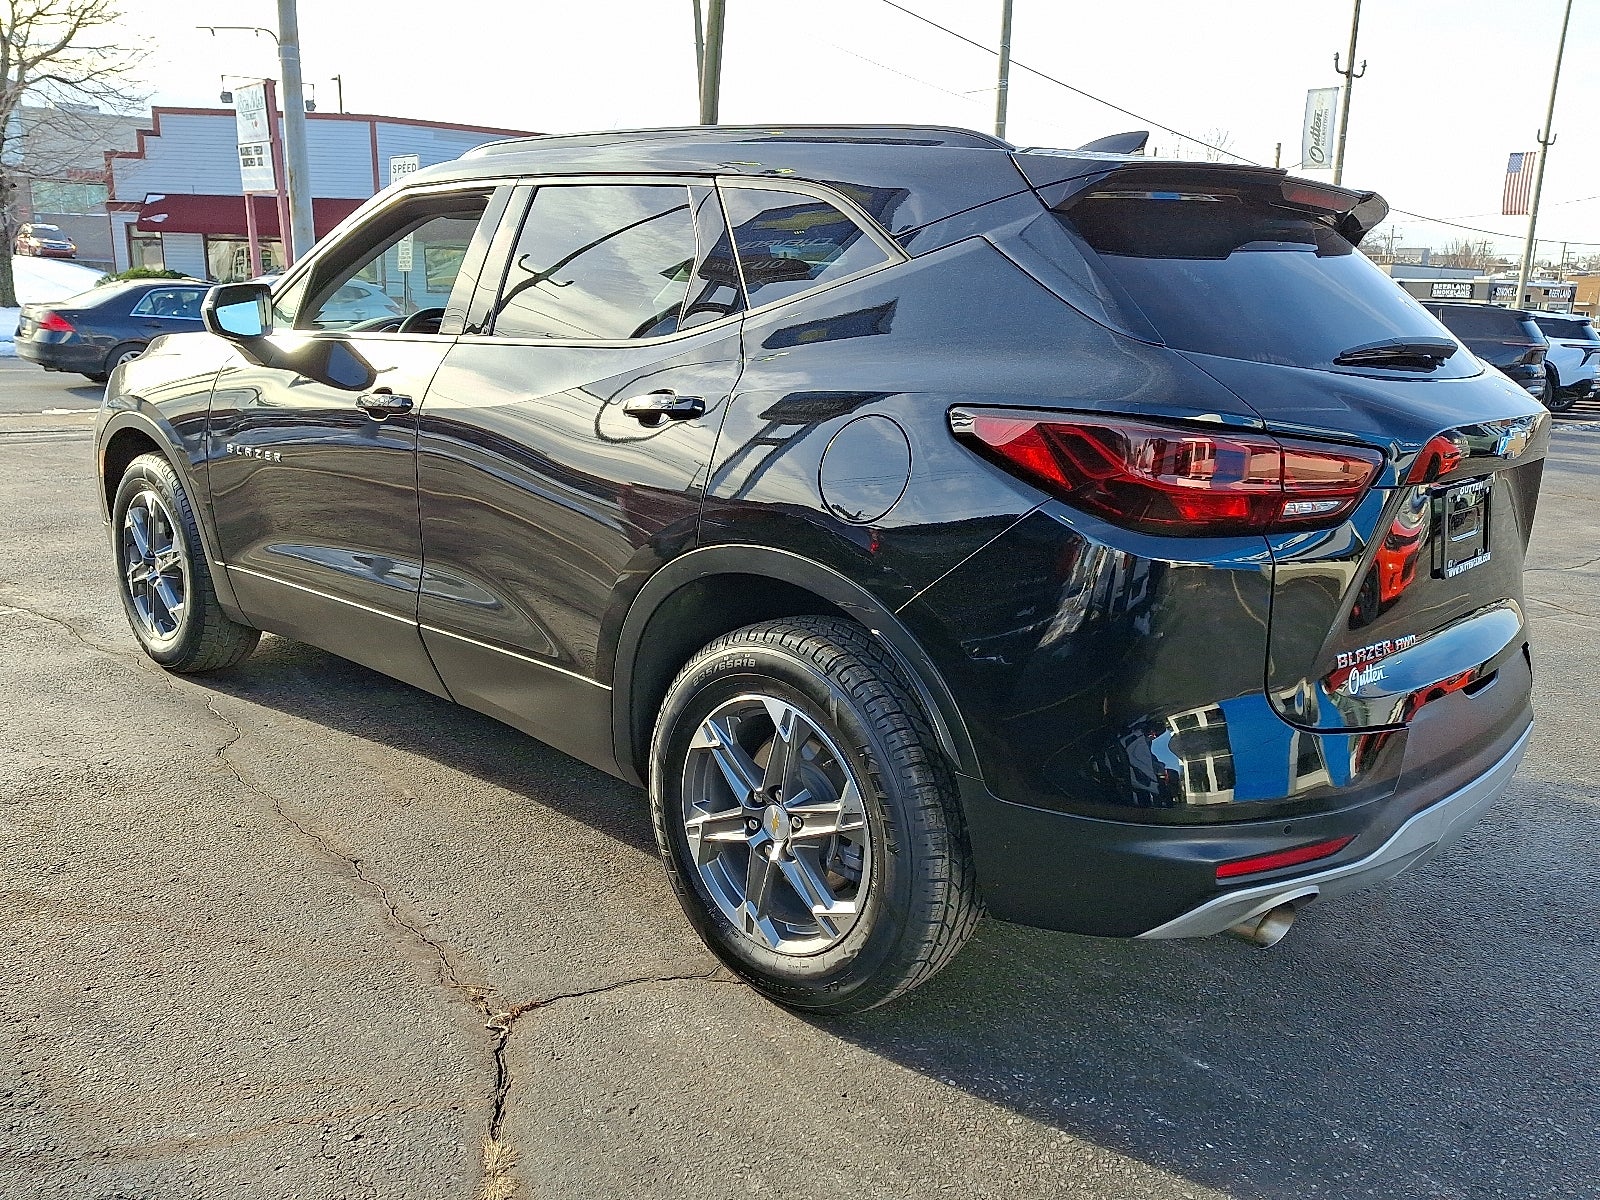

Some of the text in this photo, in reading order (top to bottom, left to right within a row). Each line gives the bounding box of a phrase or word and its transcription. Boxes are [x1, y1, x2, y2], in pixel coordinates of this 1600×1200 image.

[392, 163, 417, 174] SPEED
[226, 443, 282, 463] BLAZER
[1459, 481, 1485, 494] OUTTEN
[1336, 634, 1417, 670] BLAZER AWD
[1348, 664, 1389, 695] Outten
